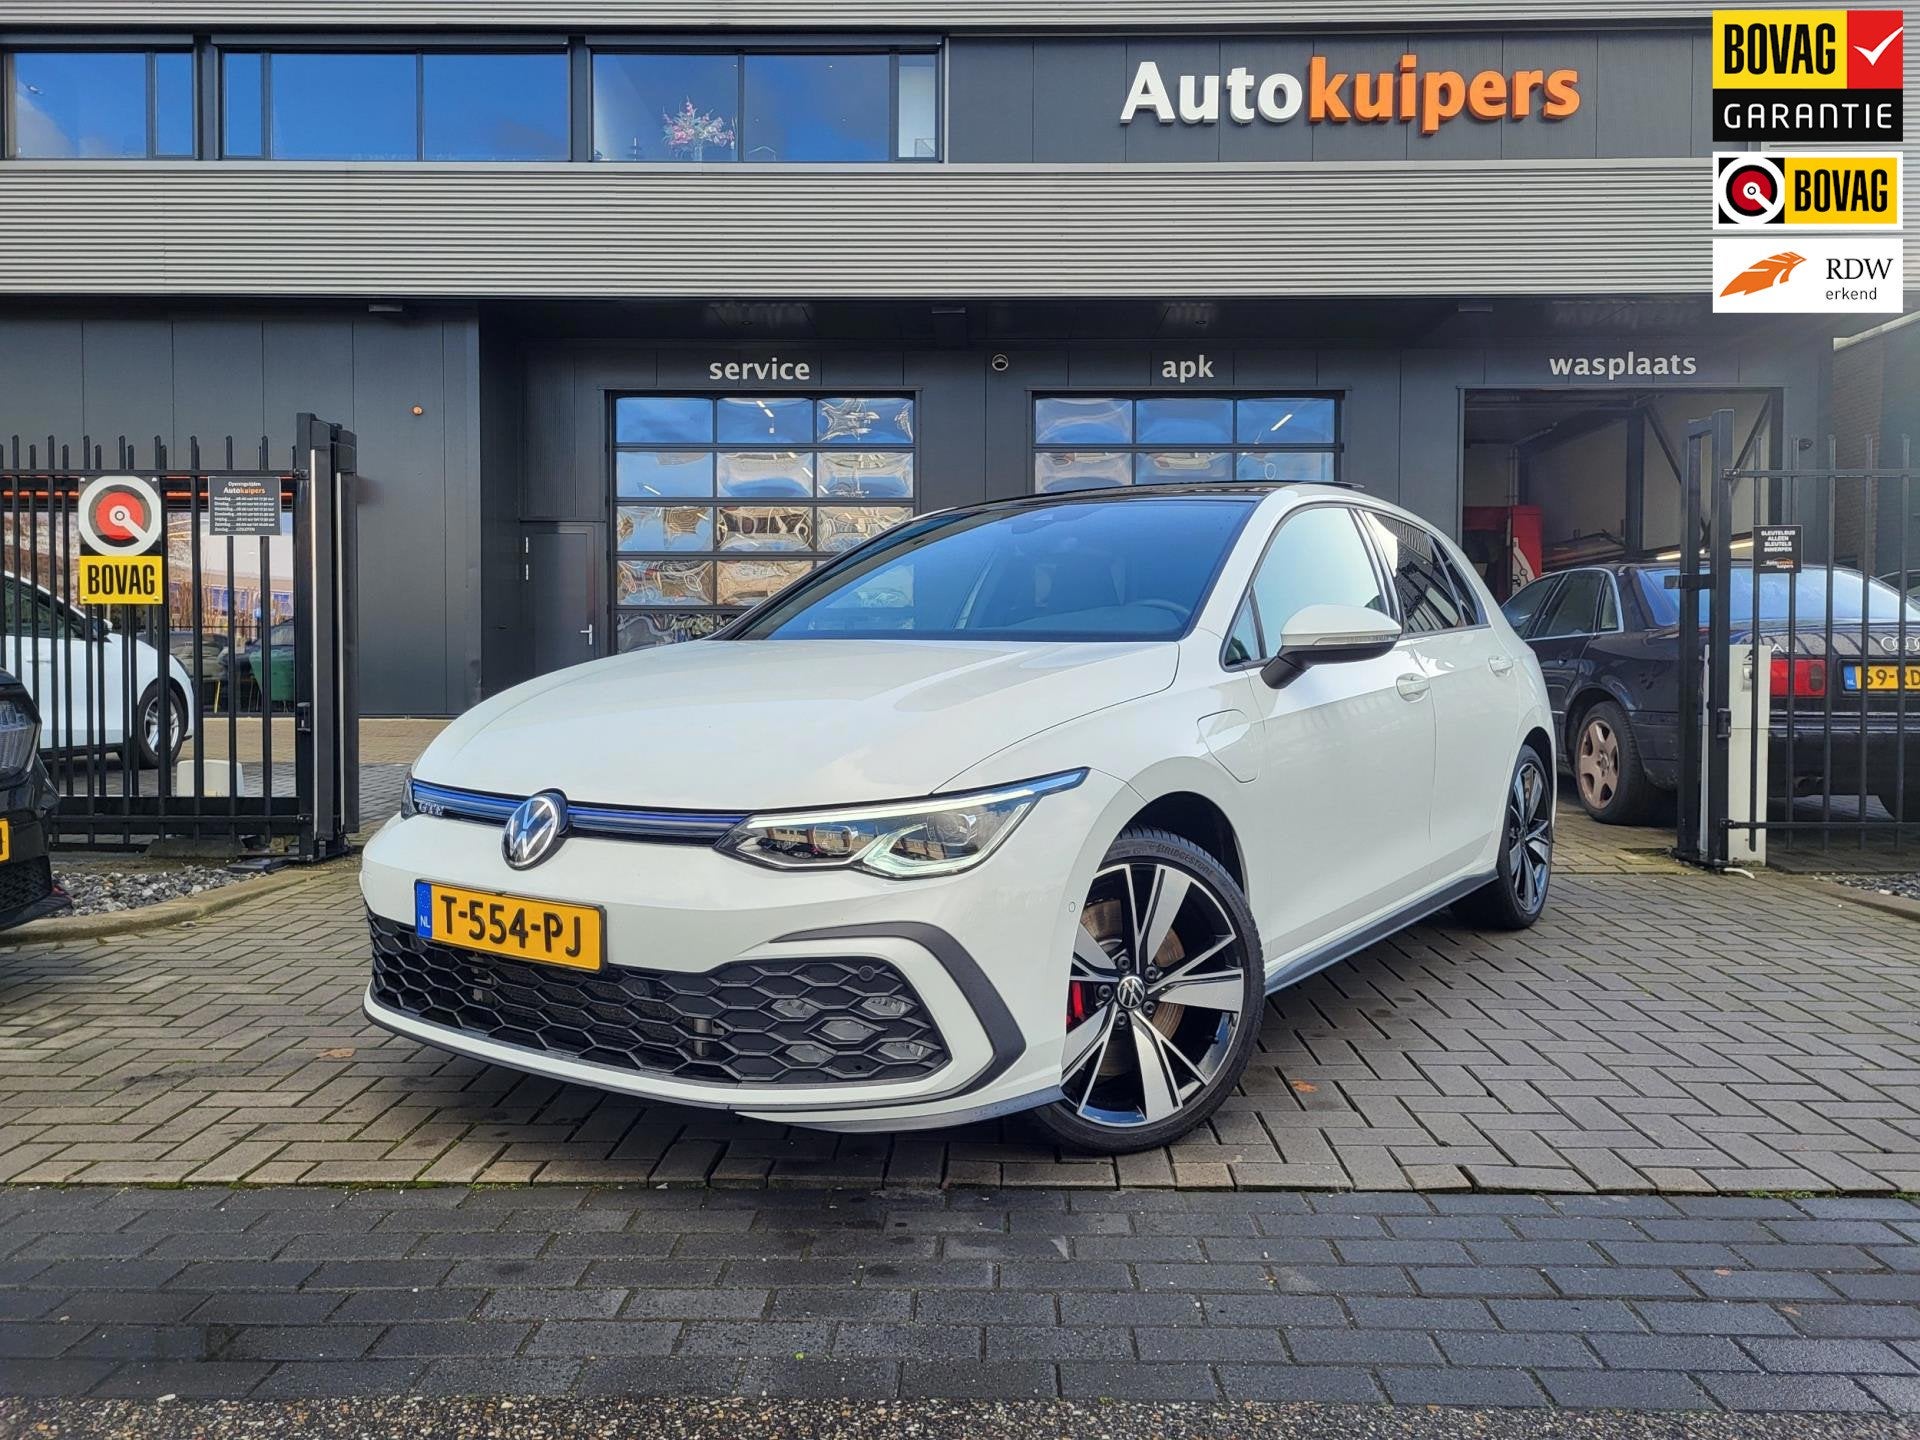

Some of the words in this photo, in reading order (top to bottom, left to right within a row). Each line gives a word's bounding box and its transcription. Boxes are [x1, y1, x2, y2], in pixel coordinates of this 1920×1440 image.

[1120, 54, 1581, 135] Autokuipers
[709, 357, 811, 381] service
[1161, 355, 1215, 383] apk
[1549, 351, 1697, 381] wasplaats
[223, 487, 266, 495] Autokuipers
[87, 564, 155, 595] BOVAG
[419, 915, 431, 929] NL
[440, 895, 582, 957] T-554-PJ
